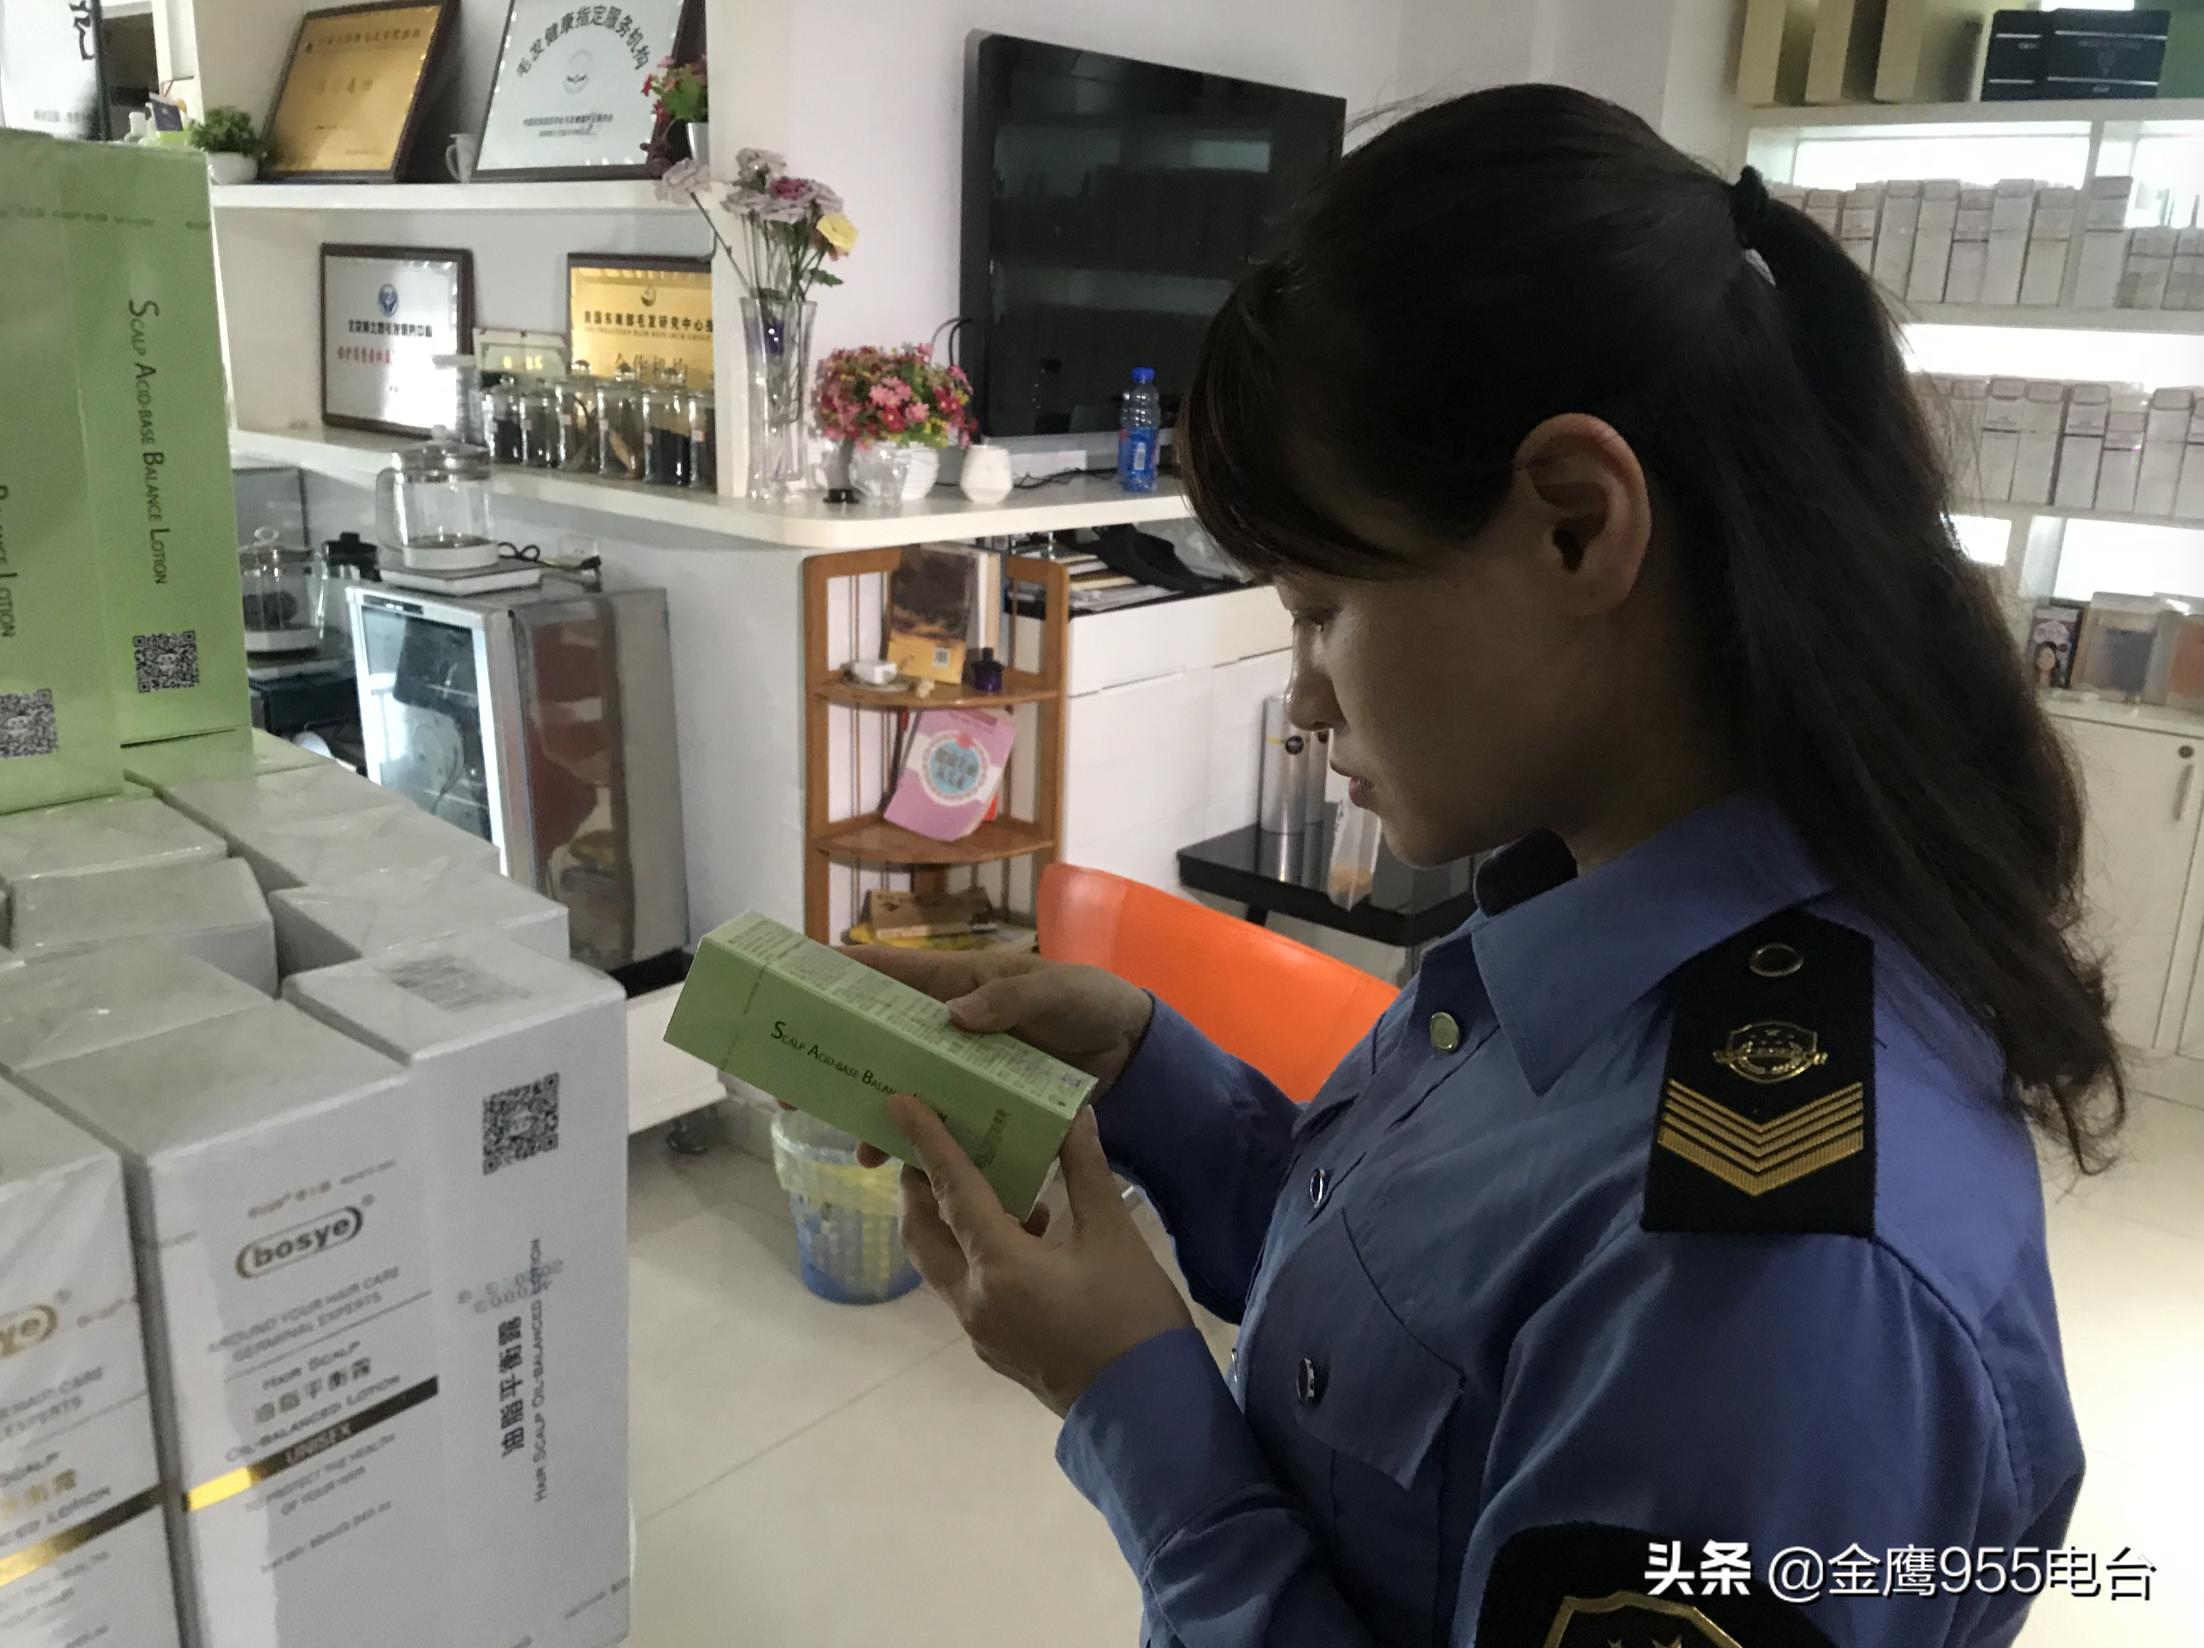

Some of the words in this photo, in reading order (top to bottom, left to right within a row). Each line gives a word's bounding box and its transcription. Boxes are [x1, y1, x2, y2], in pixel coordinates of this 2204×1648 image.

[516, 5, 650, 78] 毛发健康指定服务机构
[143, 452, 165, 522] BALANCE
[150, 528, 168, 585] LOTION
[861, 1069, 897, 1096] BALAN
[253, 1217, 351, 1268] bosye
[498, 1315, 525, 1459] 油脂平衡露
